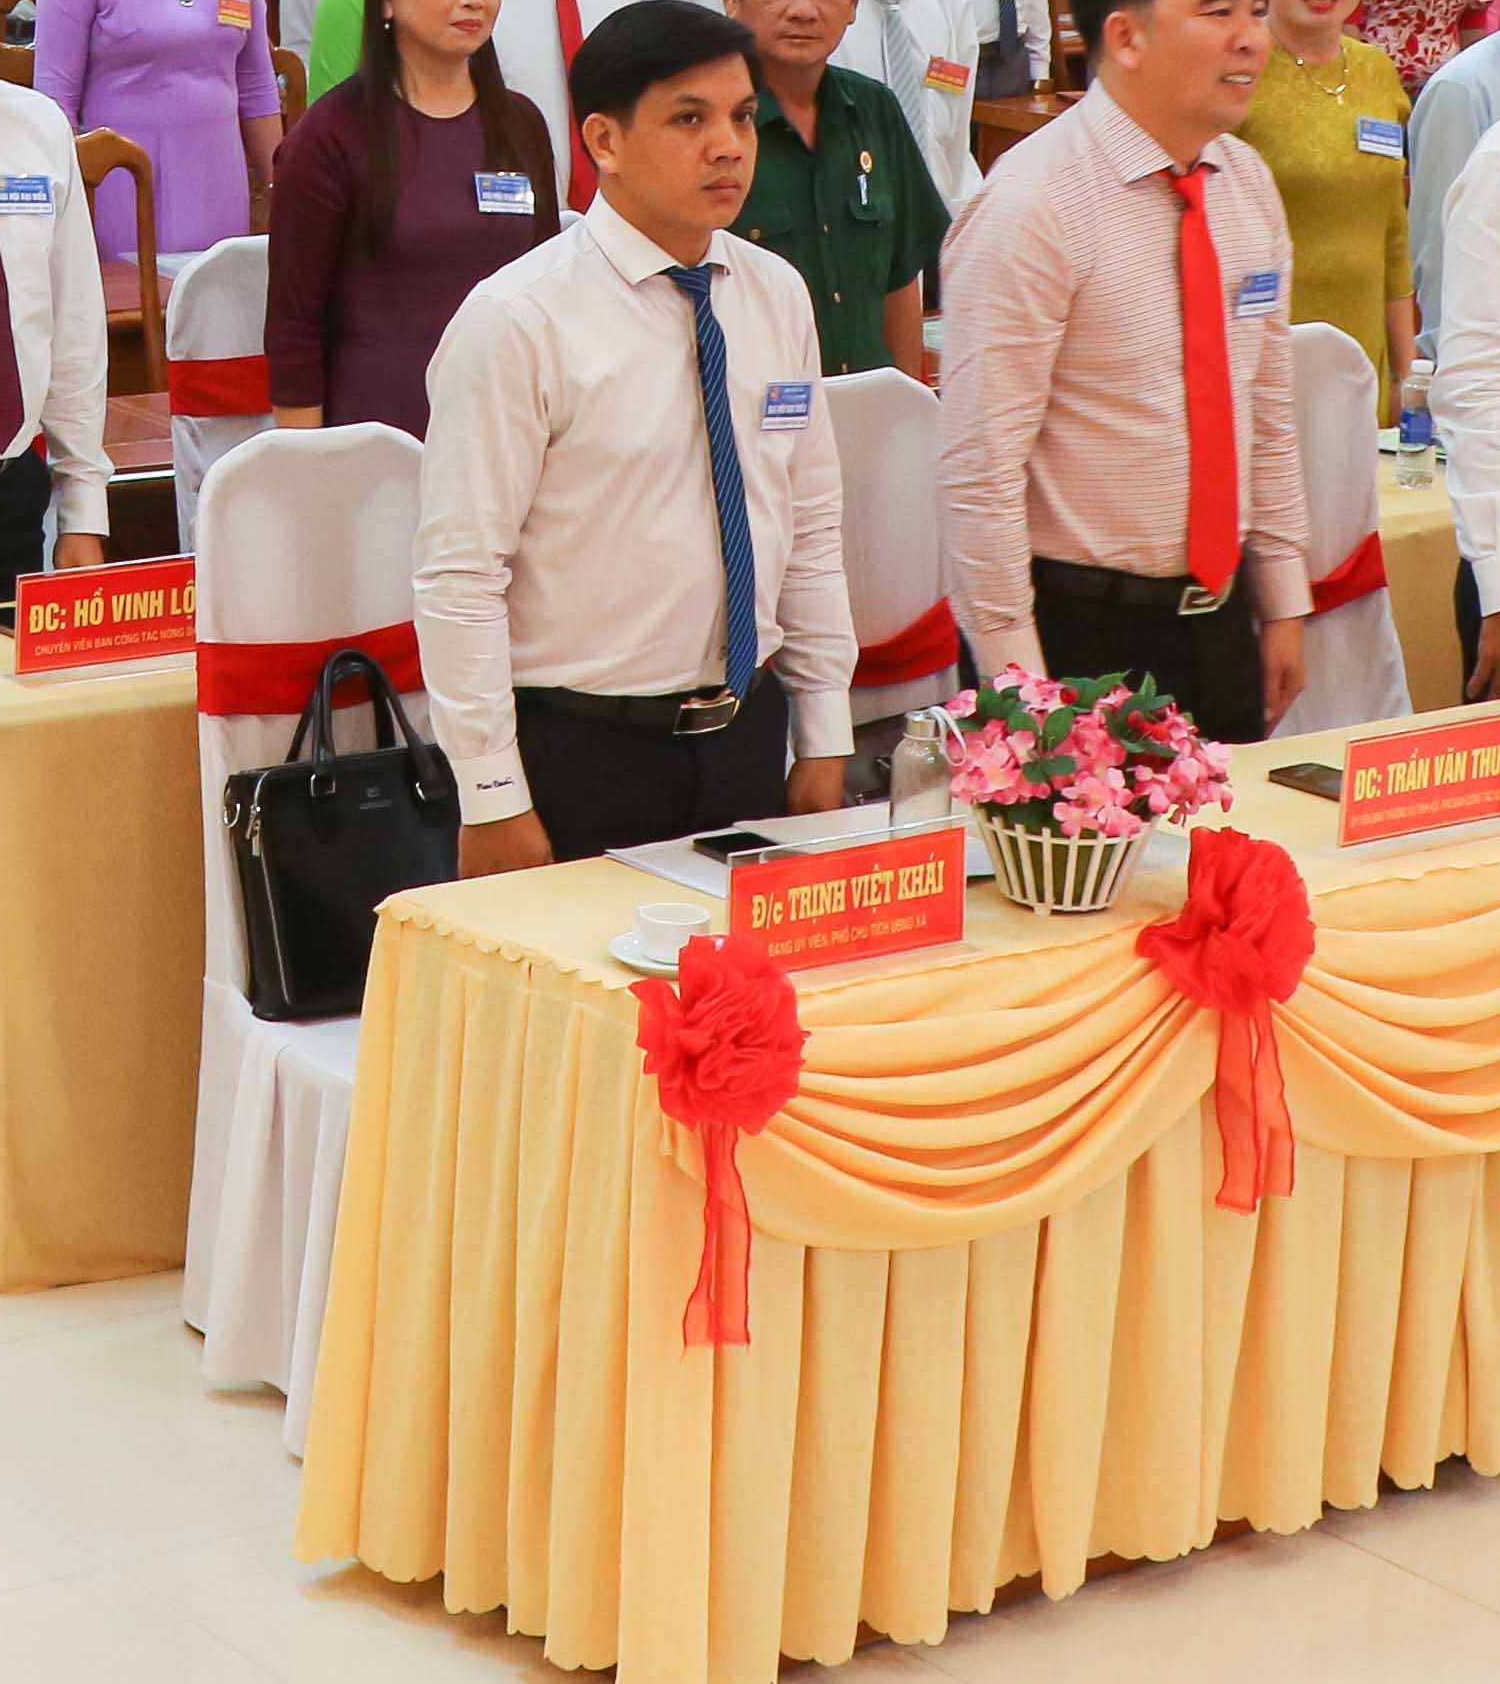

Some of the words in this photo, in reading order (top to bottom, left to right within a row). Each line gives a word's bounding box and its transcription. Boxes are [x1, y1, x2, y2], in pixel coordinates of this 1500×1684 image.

[29, 603, 66, 634] ĐC:
[112, 589, 164, 623] VINH
[170, 580, 196, 620] LỘ
[95, 636, 113, 648] BAN
[1354, 767, 1382, 801] ĐC:
[1434, 747, 1467, 786] VĂN
[751, 891, 784, 930] Đ/c
[788, 878, 846, 925] TRỊNH
[851, 863, 894, 913] VIỆT
[897, 852, 945, 901] KHÁI
